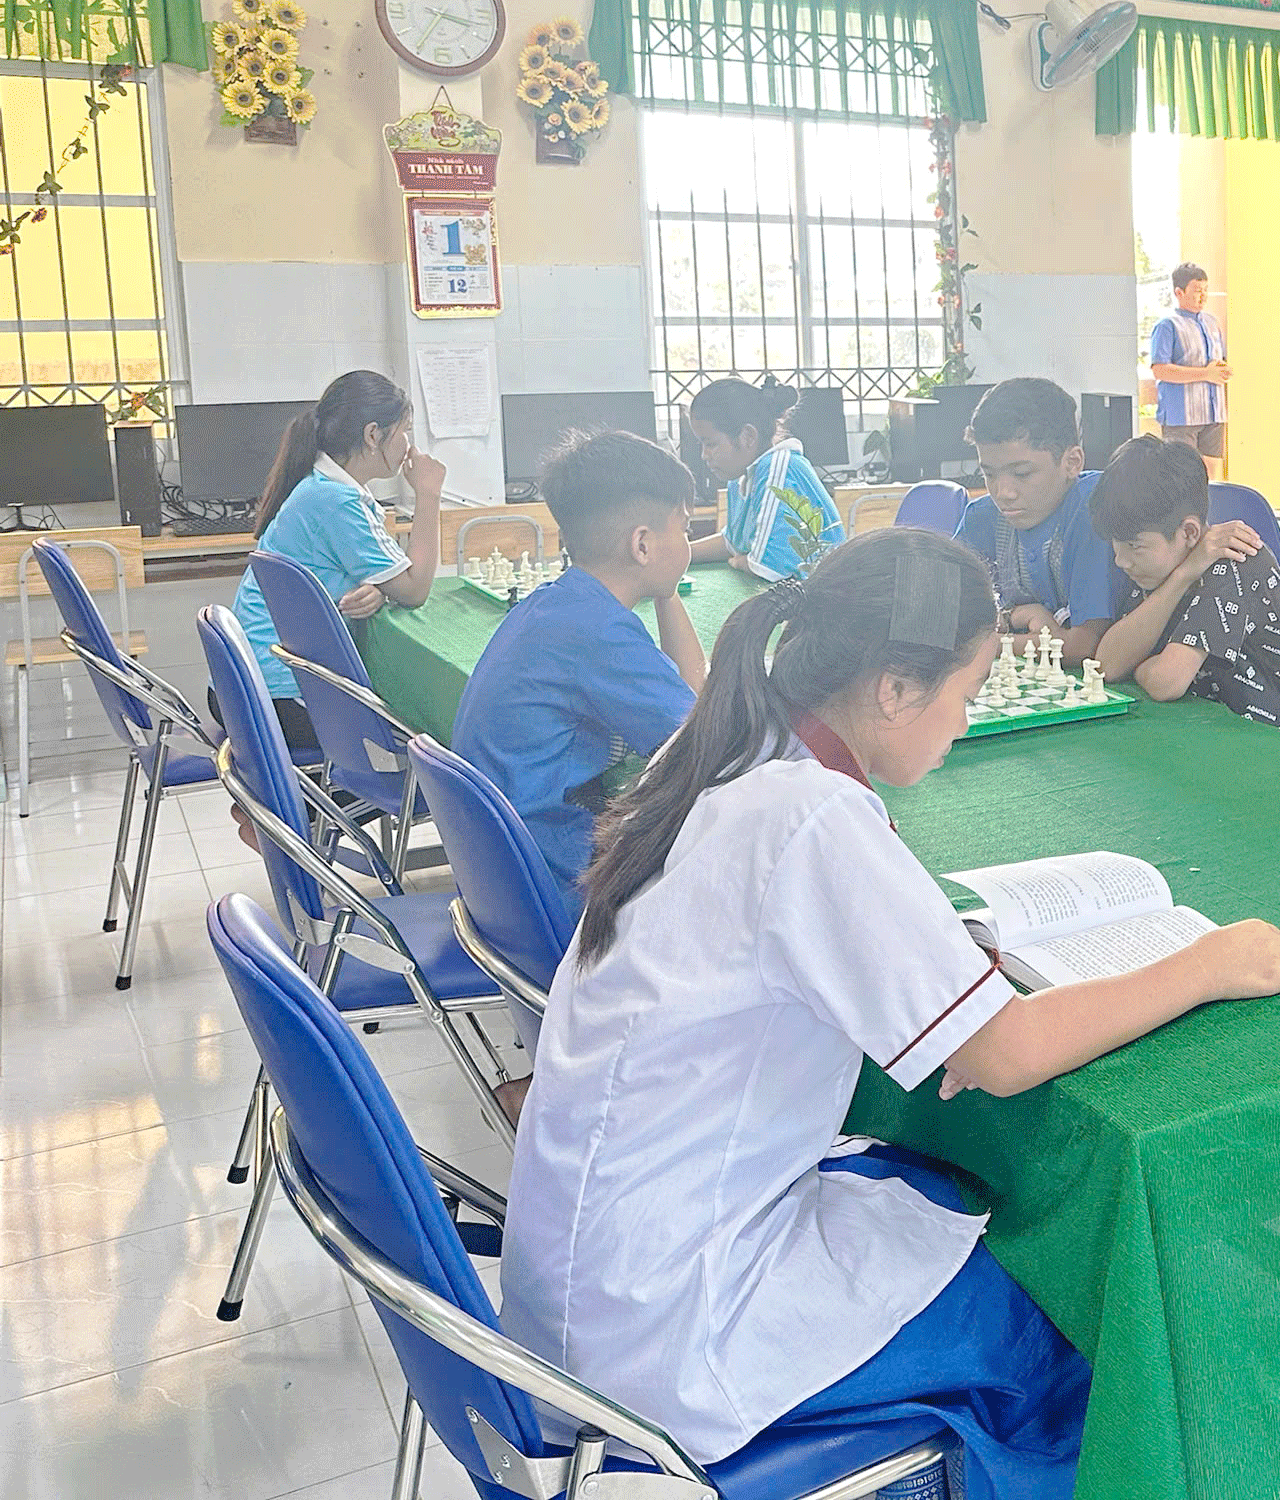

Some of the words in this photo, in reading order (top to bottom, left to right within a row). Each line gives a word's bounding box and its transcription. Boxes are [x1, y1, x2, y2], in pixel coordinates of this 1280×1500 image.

[407, 163, 453, 175] THANH
[440, 220, 466, 255] 1
[447, 278, 468, 293] 12
